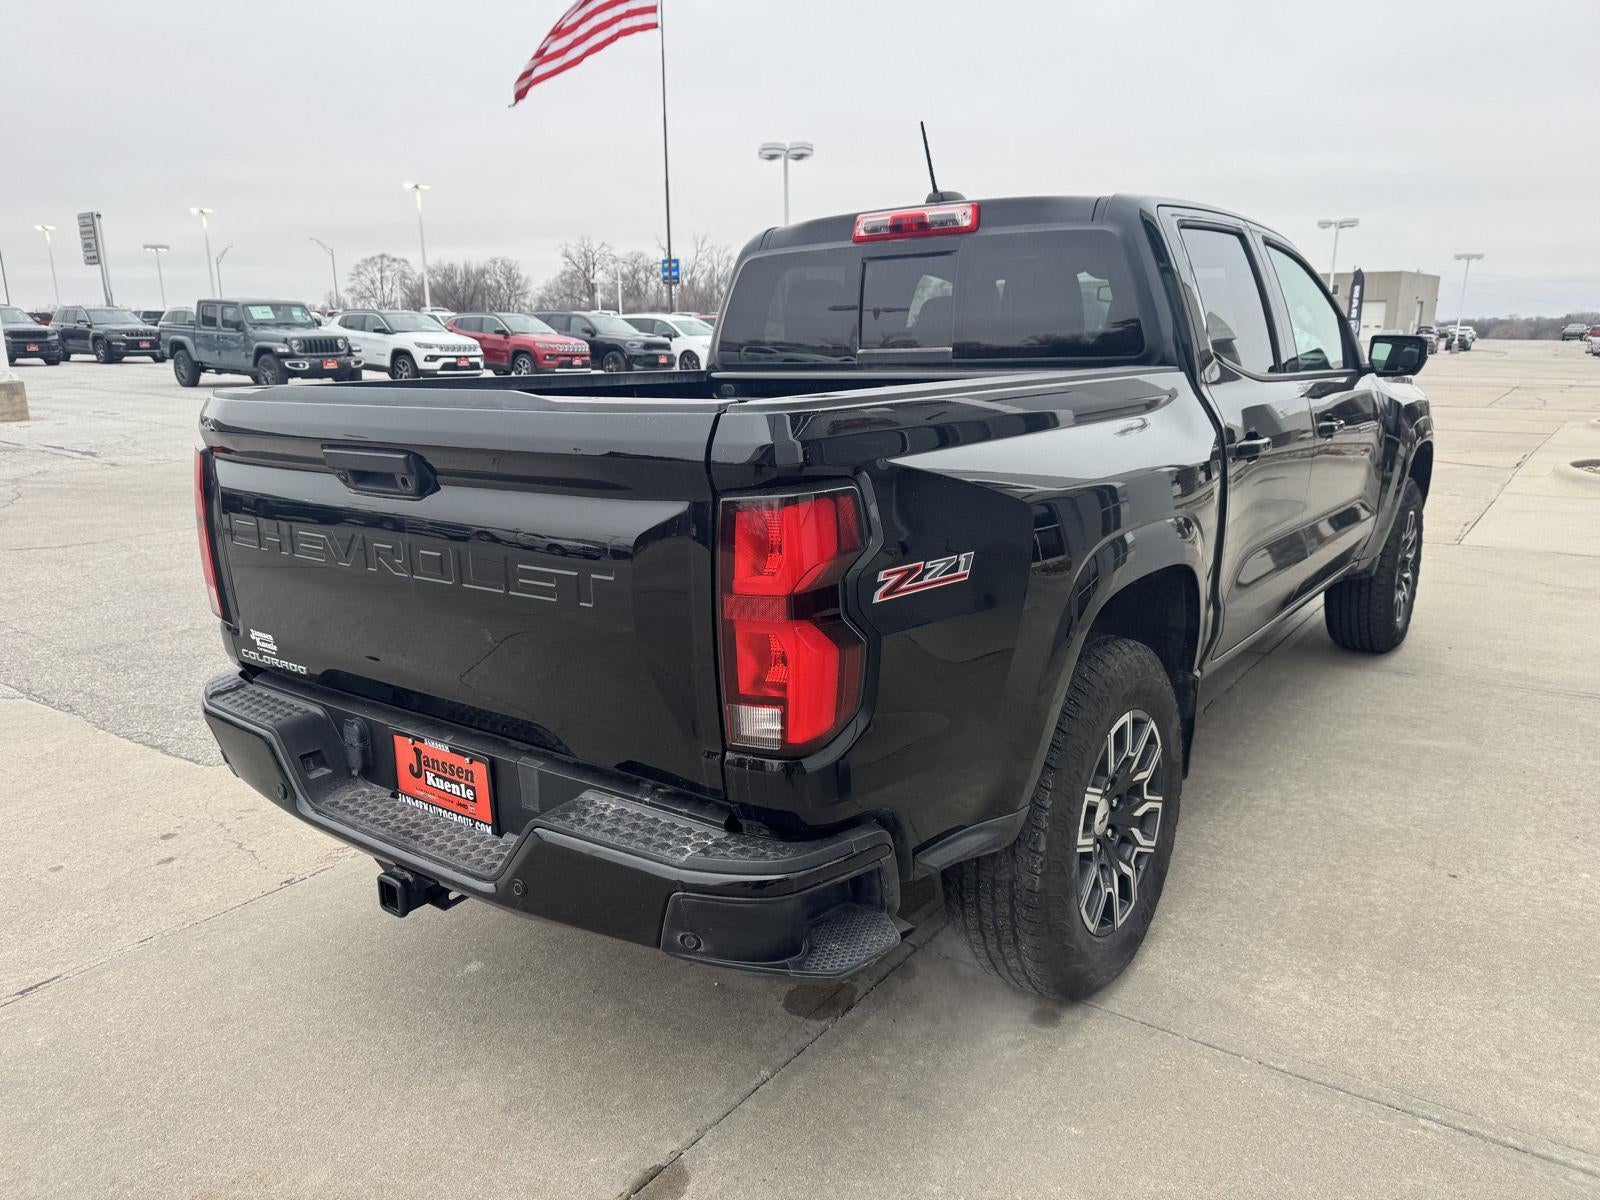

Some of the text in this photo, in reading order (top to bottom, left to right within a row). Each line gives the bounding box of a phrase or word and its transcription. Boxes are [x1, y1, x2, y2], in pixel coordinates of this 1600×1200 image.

[230, 512, 615, 608] CHEVROLET
[872, 551, 975, 604] Z71
[241, 648, 307, 674] COLORADO
[408, 746, 475, 784] Janssen
[425, 770, 475, 801] Kuenle
